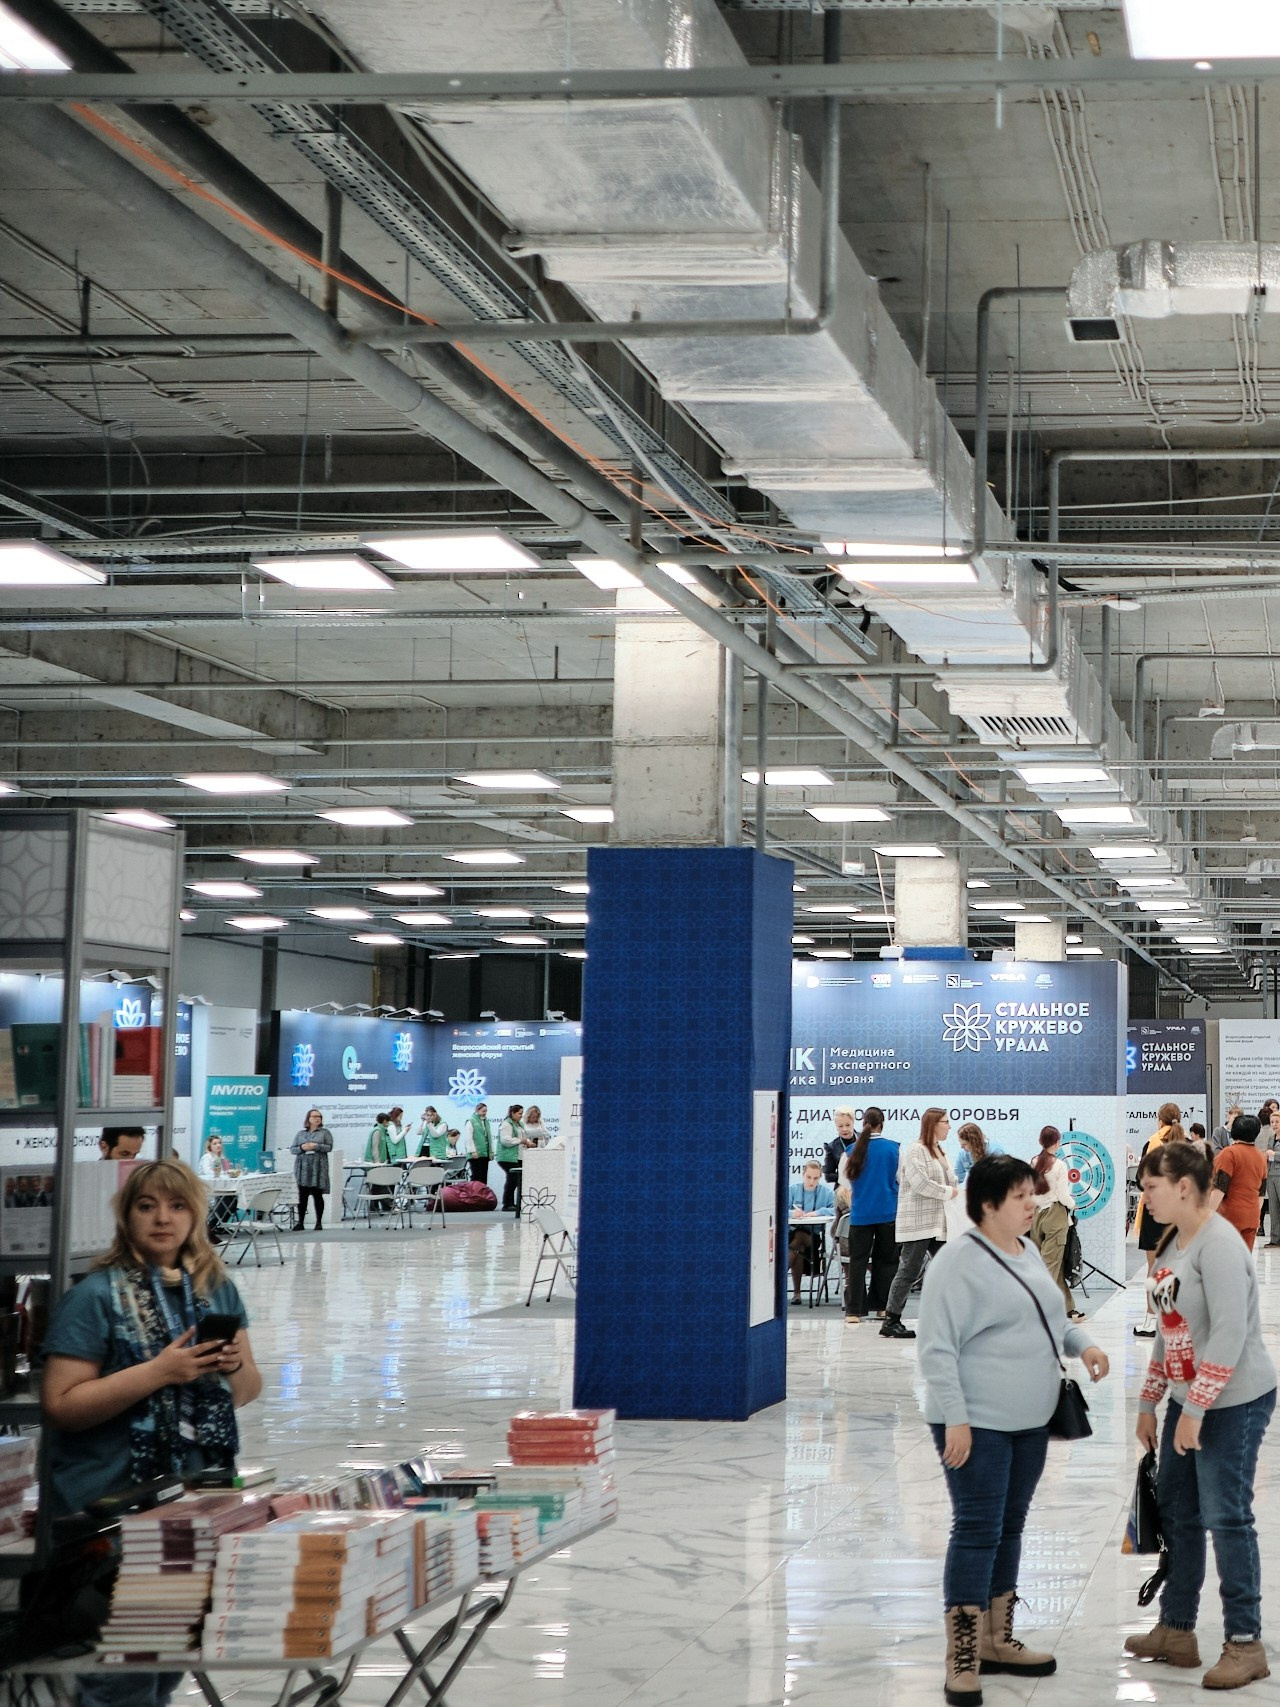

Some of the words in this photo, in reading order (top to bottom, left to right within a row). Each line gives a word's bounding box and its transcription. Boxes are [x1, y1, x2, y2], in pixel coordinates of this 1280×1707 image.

[995, 1002, 1090, 1017] СТАЛЬНОЕ
[995, 1020, 1083, 1034] КРУЖЕВО
[995, 1037, 1050, 1052] УРАЛА
[1142, 1042, 1196, 1051] СТАЛЬНОЕ
[829, 1047, 895, 1057] Медицина
[1142, 1053, 1192, 1061] КРУЖЕВО
[829, 1061, 911, 1071] экспертного
[1142, 1063, 1172, 1071] УРАЛА
[829, 1075, 874, 1085] уровня
[210, 1085, 264, 1095] INVITRO
